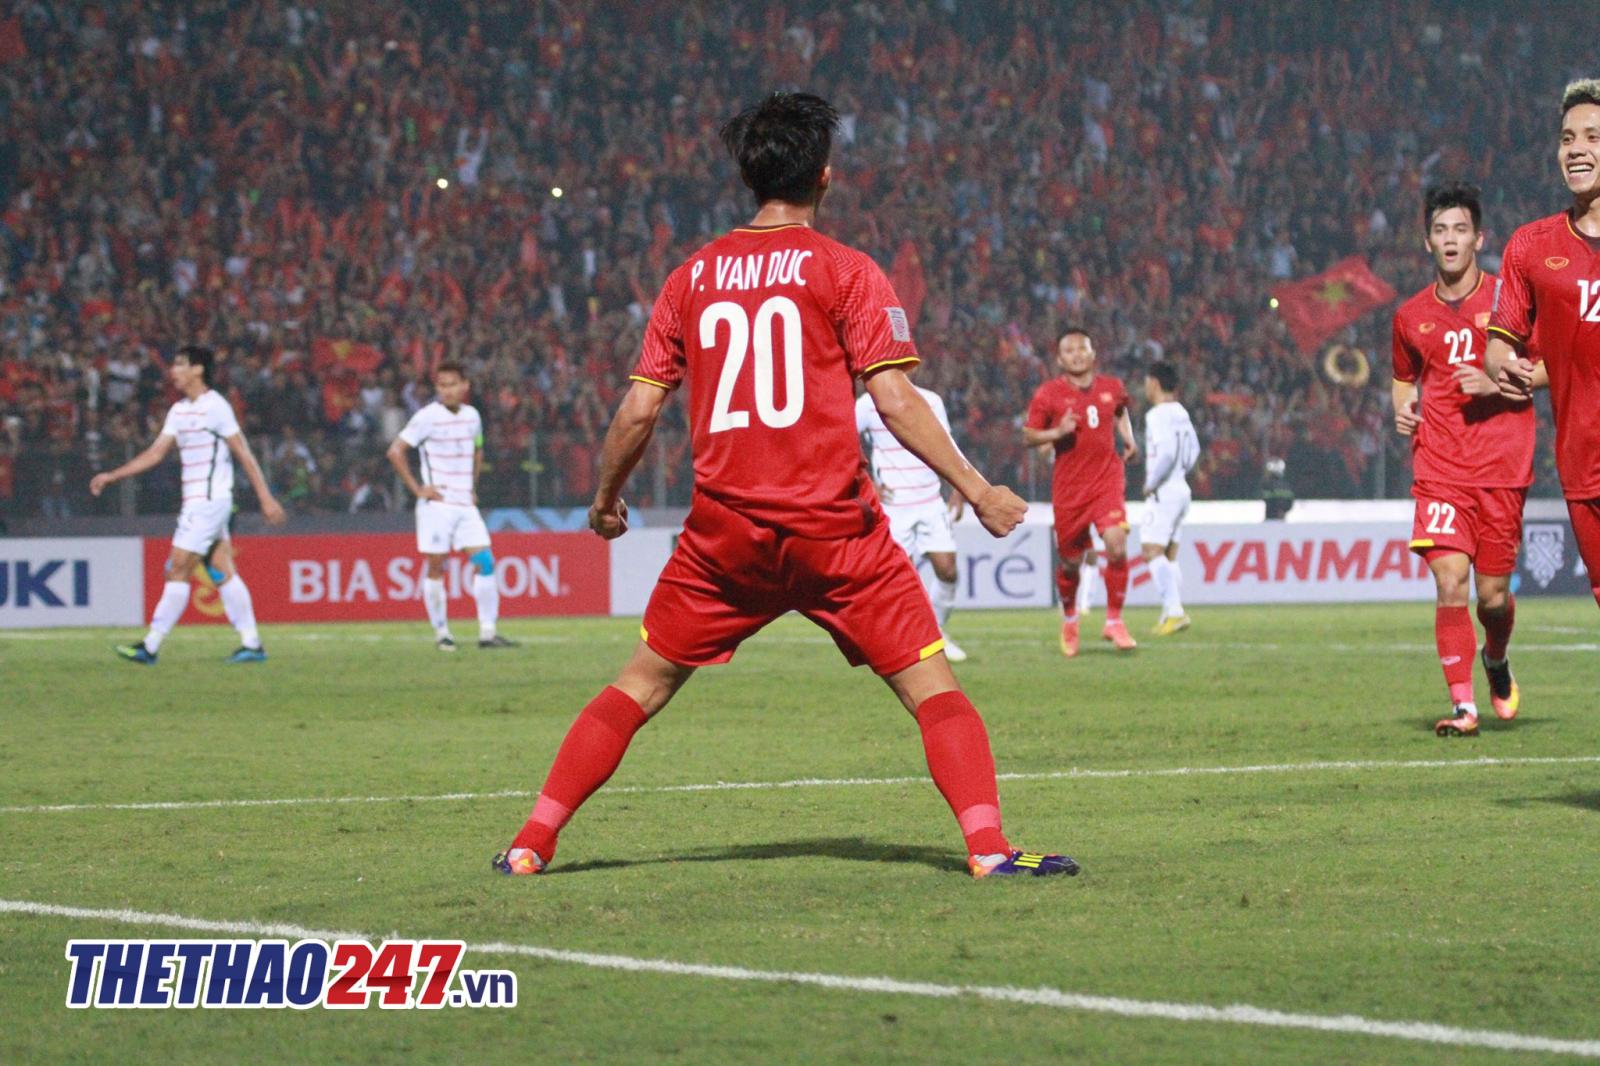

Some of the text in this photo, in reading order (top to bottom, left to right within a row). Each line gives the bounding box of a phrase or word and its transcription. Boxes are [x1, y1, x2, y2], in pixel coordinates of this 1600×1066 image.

[691, 248, 813, 295] P. VAN DUC
[699, 295, 805, 434] 20
[1444, 327, 1477, 365] 22
[1086, 404, 1099, 429] 8
[1426, 501, 1456, 535] 22
[0, 559, 89, 608] KI
[290, 558, 380, 604] BIA
